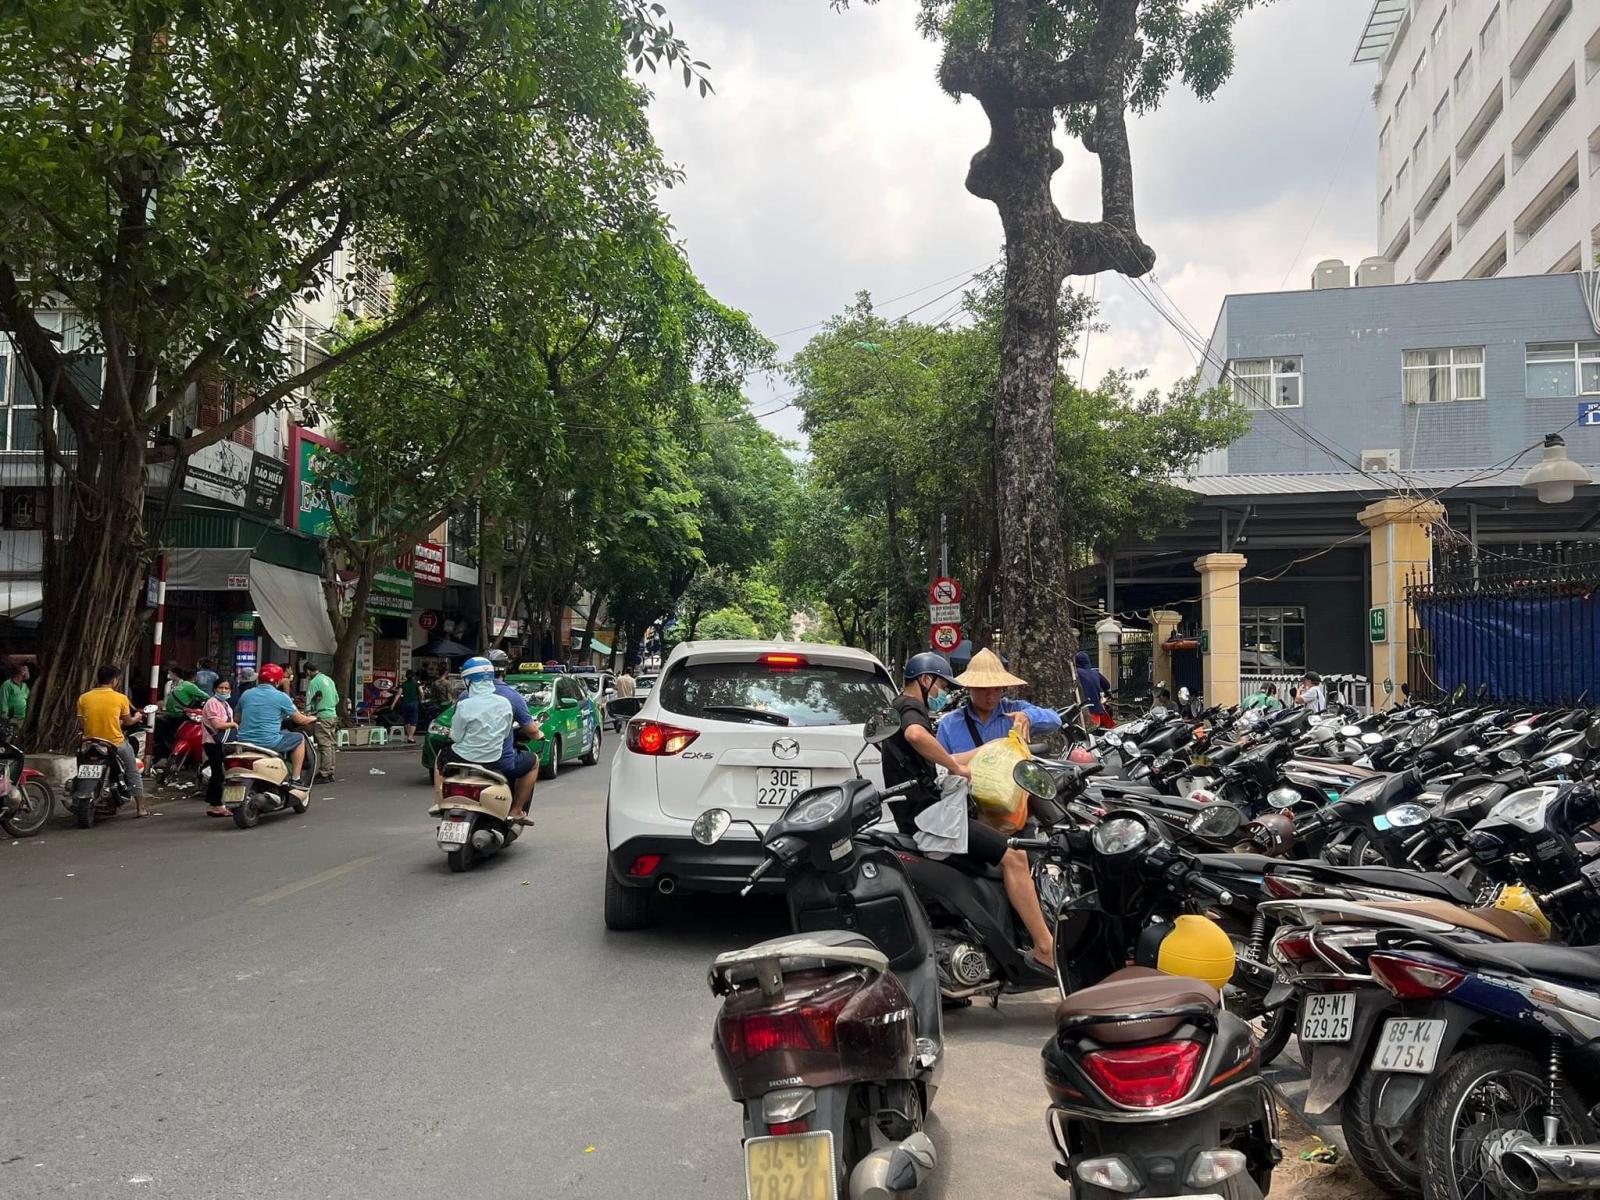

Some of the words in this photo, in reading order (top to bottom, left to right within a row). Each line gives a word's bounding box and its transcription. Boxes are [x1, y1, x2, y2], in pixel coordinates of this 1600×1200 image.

[1373, 611, 1383, 627] 16
[770, 769, 799, 787] 30E
[1311, 995, 1347, 1016] 29-N1
[1304, 1018, 1349, 1038] 629.25
[1388, 1021, 1432, 1043] 89-K4
[1380, 1045, 1424, 1069] 4754
[769, 1077, 804, 1088] HONDA
